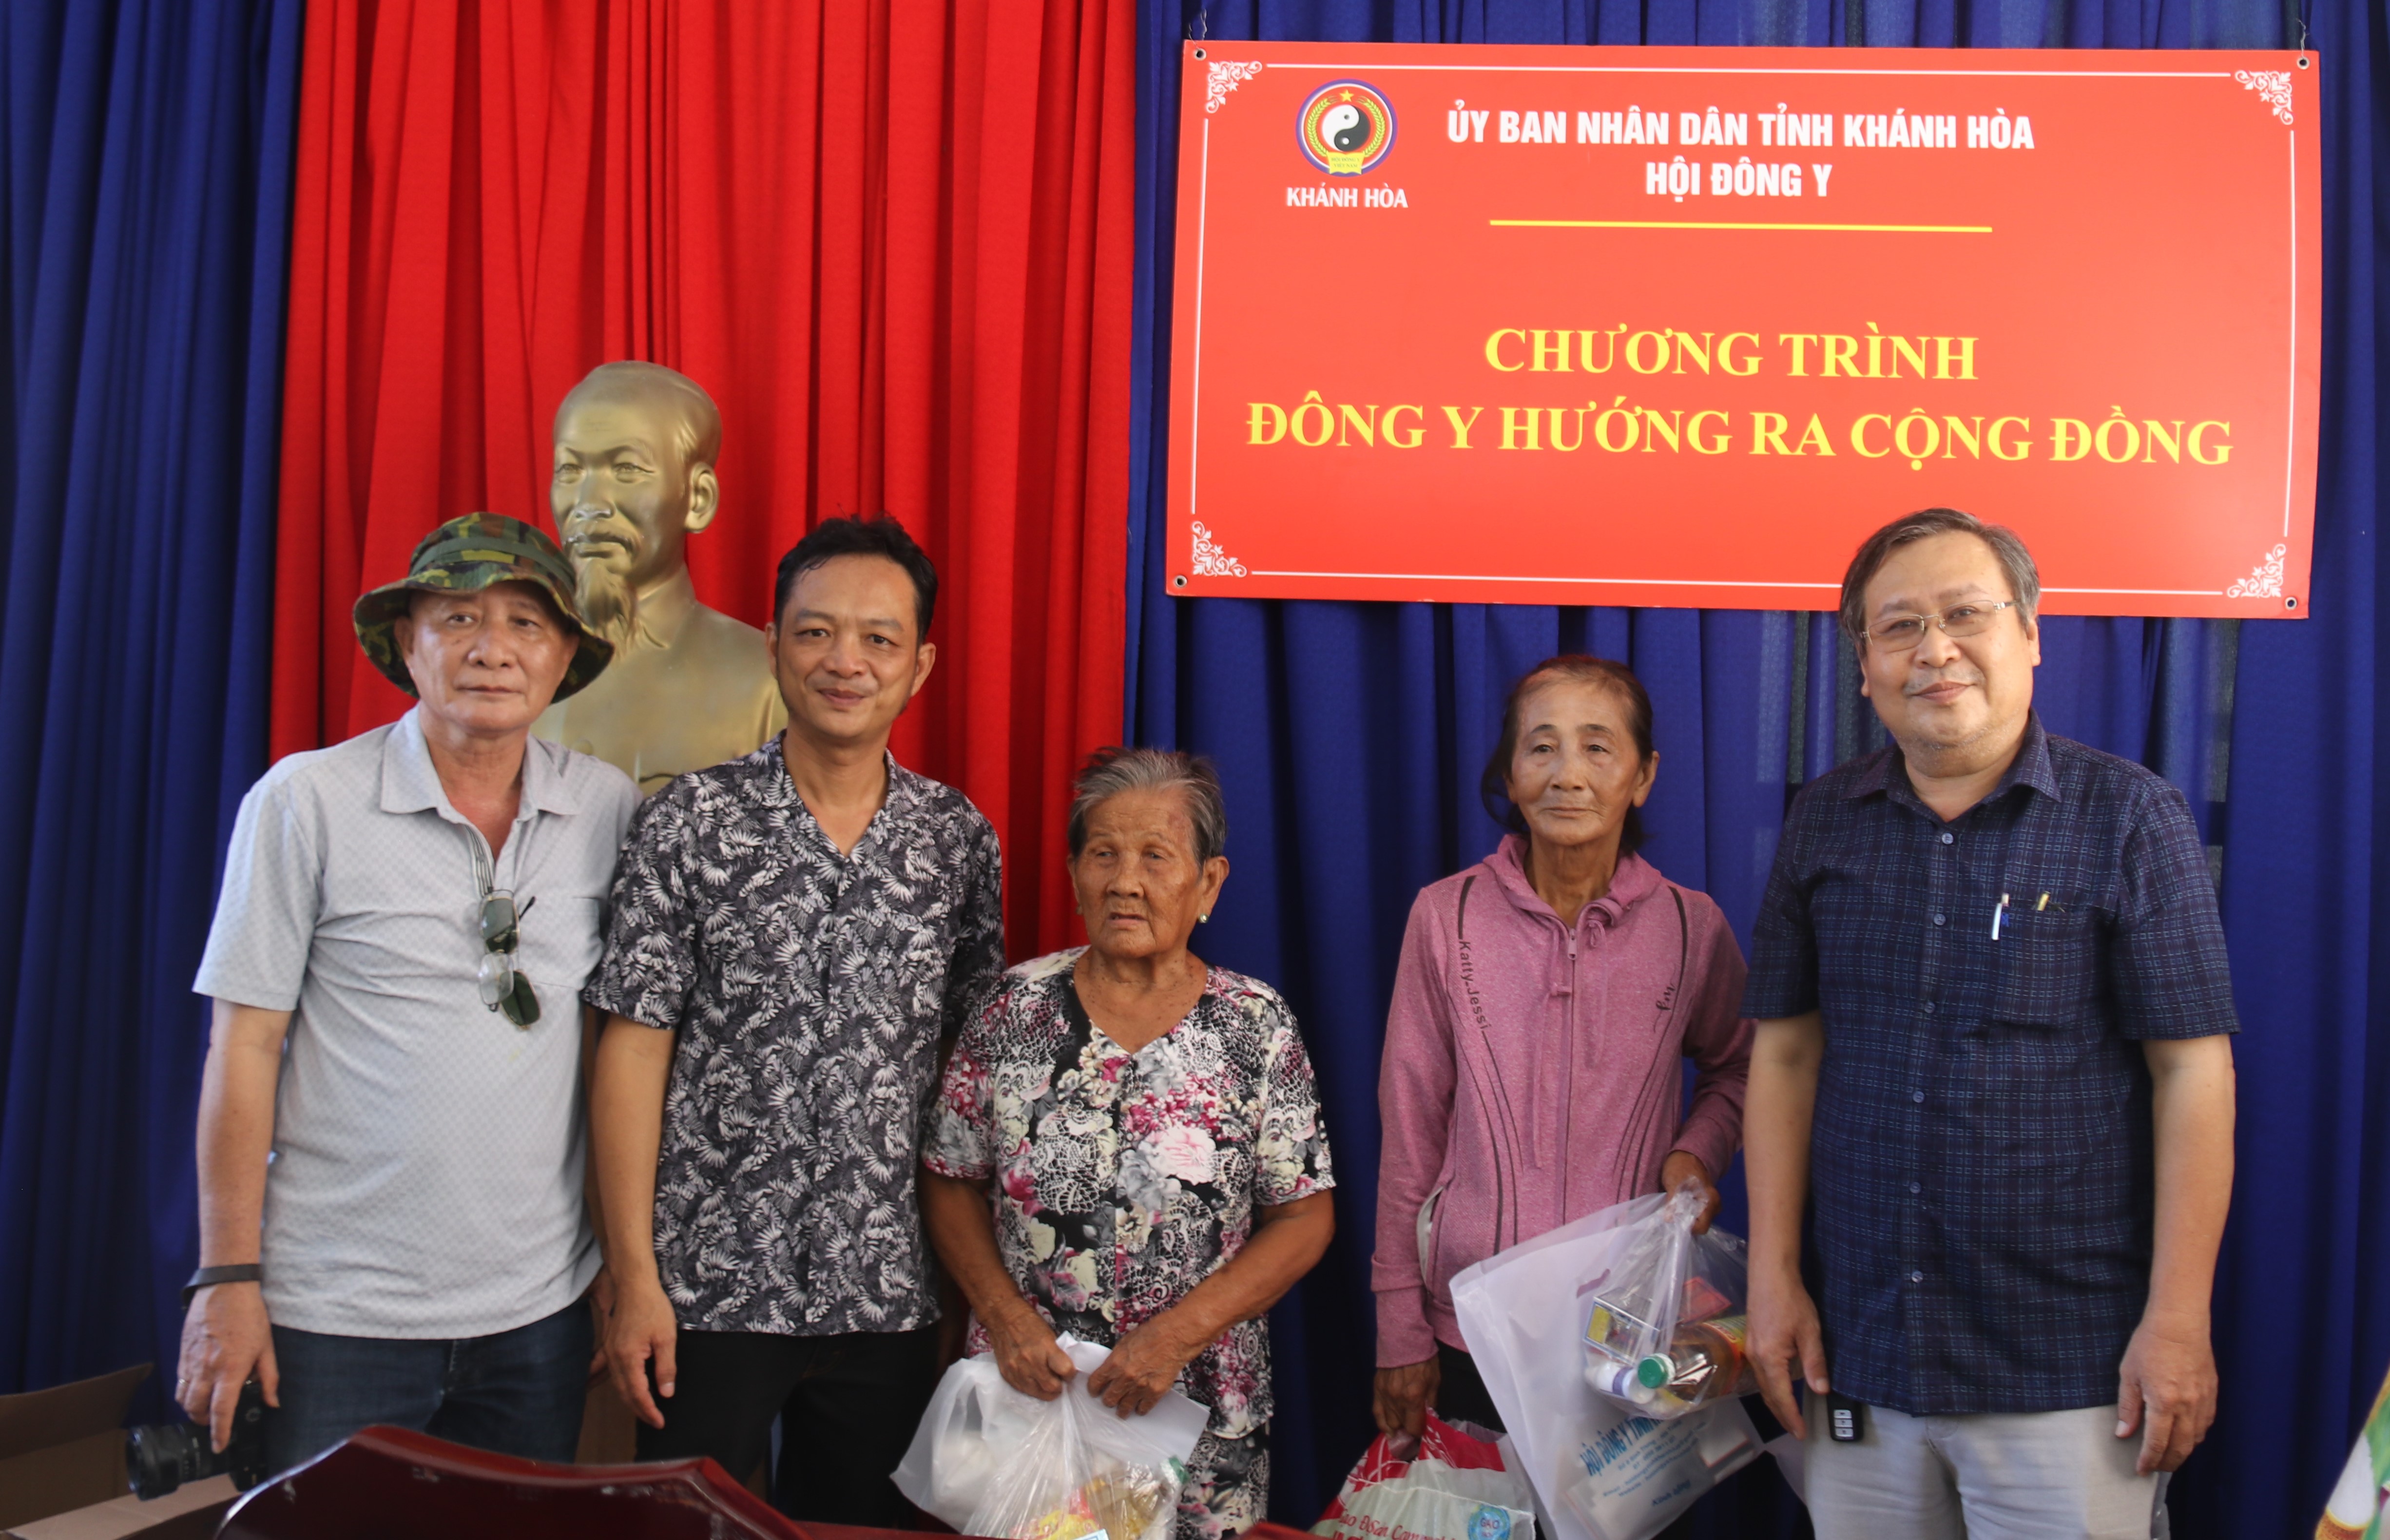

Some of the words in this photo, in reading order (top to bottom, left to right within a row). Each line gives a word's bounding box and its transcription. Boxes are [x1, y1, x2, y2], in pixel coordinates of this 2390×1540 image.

[1448, 99, 1490, 143] ỦY
[1499, 111, 1567, 144] BAN
[1577, 105, 1669, 145] NHÂN
[1679, 106, 1748, 146] DÂN
[1757, 102, 1833, 147] TỈNH
[1844, 108, 1957, 148] KHÁNH
[1967, 107, 2035, 150] HÒA
[1287, 182, 1358, 208] KHÁNH
[1365, 182, 1408, 208] HÒA
[1646, 155, 1700, 203] HỘI
[1710, 156, 1802, 197] ĐÔNG
[1812, 164, 1832, 197] Y
[1484, 323, 1763, 376] CHƯƠNG
[1779, 321, 1979, 380] TRÌNH
[1246, 390, 1426, 448] ĐÔNG
[1441, 406, 1484, 448] Y
[1498, 395, 1733, 455] HƯỚNG
[1749, 410, 1837, 457] RA
[1850, 407, 2034, 471] CỘNG
[2049, 404, 2234, 465] ĐỒNG
[1459, 941, 1491, 1029] Katty-Jessi
[1580, 1443, 1604, 1476] HỘI
[1596, 1430, 1627, 1464] ĐÔNG
[1617, 1423, 1633, 1446] Y
